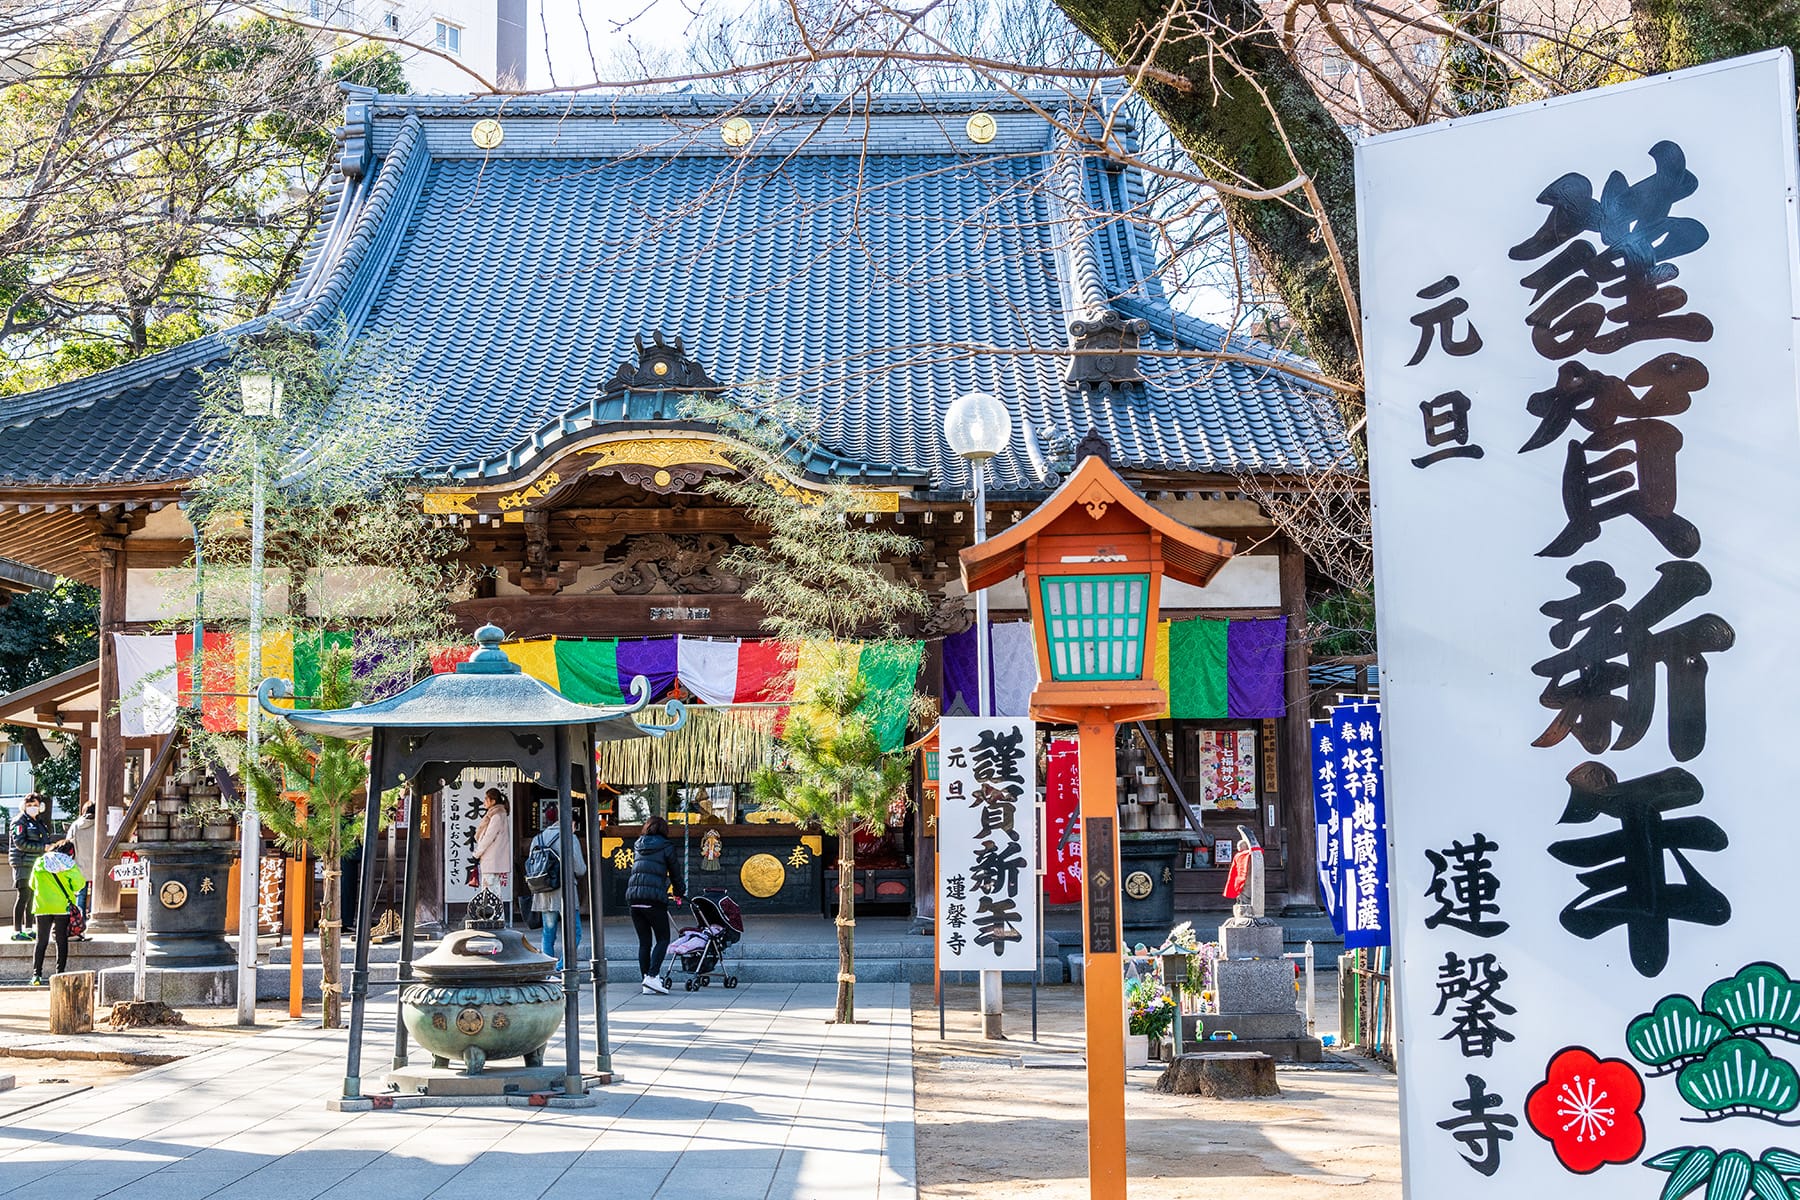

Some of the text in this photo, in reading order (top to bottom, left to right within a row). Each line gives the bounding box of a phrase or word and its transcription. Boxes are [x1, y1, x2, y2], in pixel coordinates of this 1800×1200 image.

[1406, 275, 1485, 469] 元旦
[1509, 140, 1735, 978] 謹賀新年
[946, 747, 968, 801] 元旦
[200, 877, 214, 895] 奉
[449, 793, 460, 885] ご自由にお入り下さい
[787, 845, 809, 868] 奉
[969, 725, 1027, 957] 謹賀新年
[1351, 796, 1382, 931] 地蔵菩薩
[946, 873, 967, 956] 蓮馨寺
[1424, 833, 1518, 1177] 蓮馨寺
